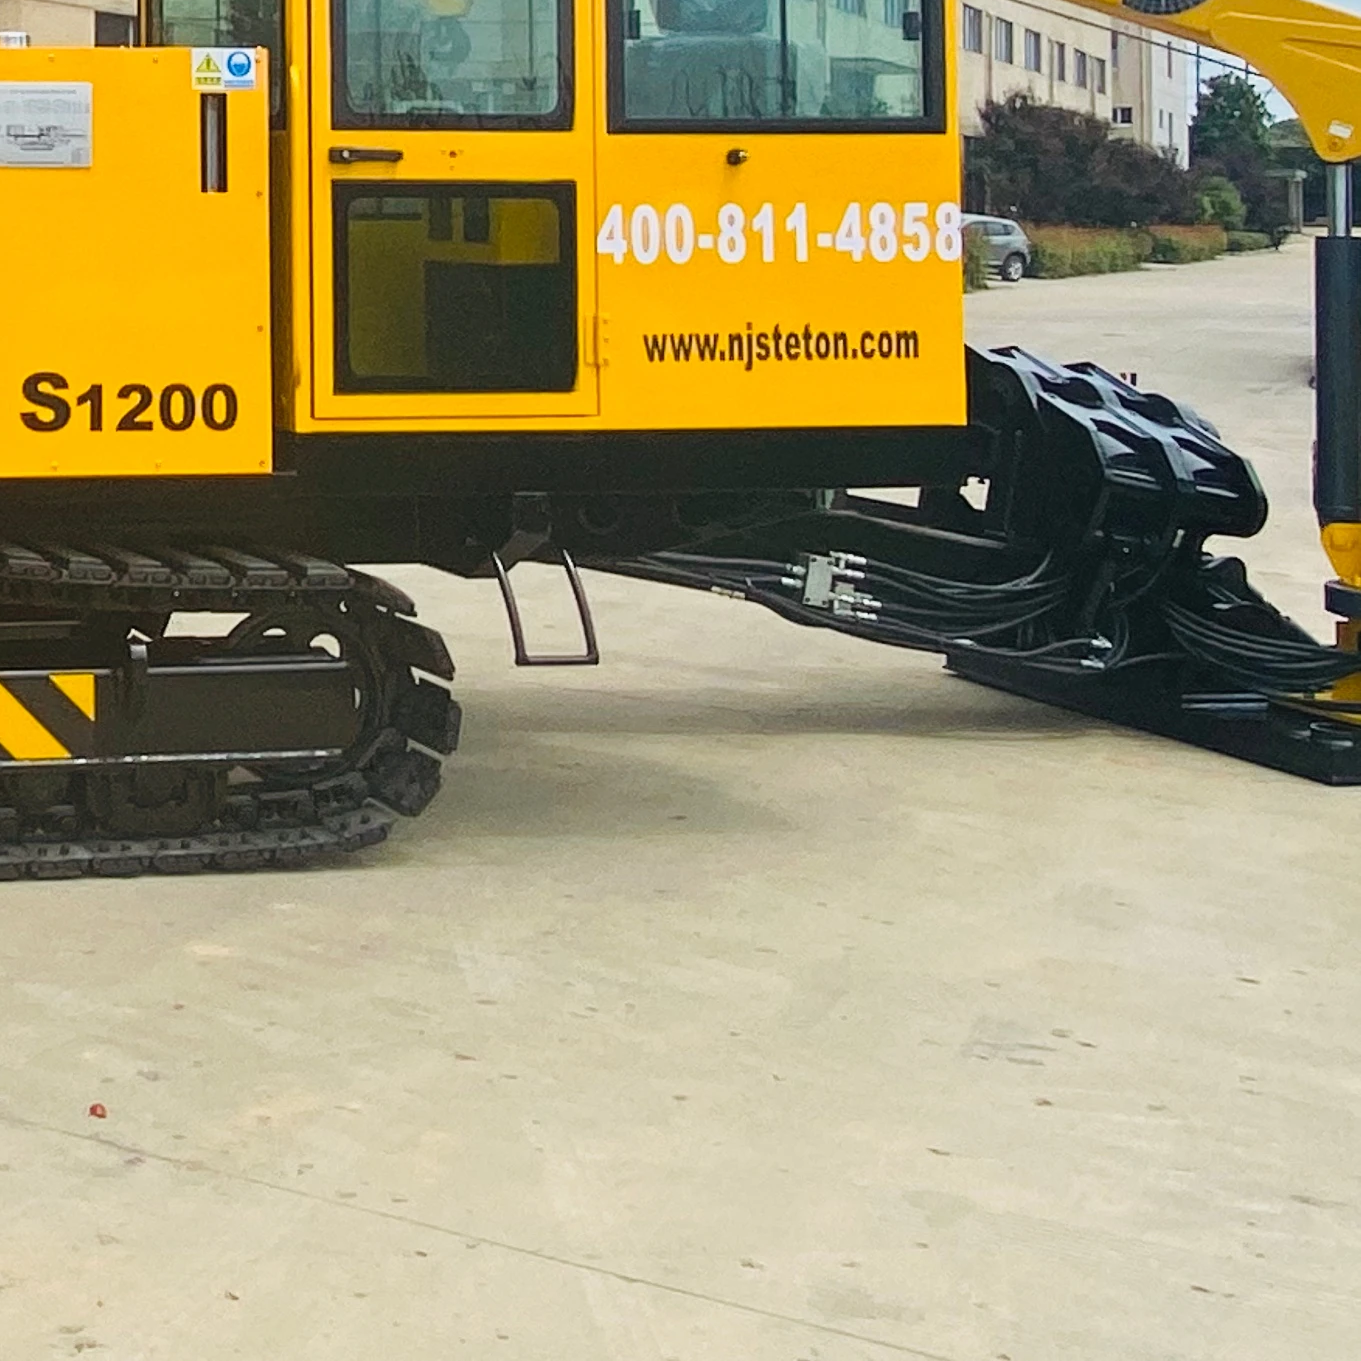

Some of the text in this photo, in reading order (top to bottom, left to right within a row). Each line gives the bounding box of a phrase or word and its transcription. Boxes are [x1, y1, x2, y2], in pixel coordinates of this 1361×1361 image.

[596, 202, 962, 265] 400-811-4858
[643, 322, 919, 371] www.njsteton.com
[19, 371, 238, 432] S1200
